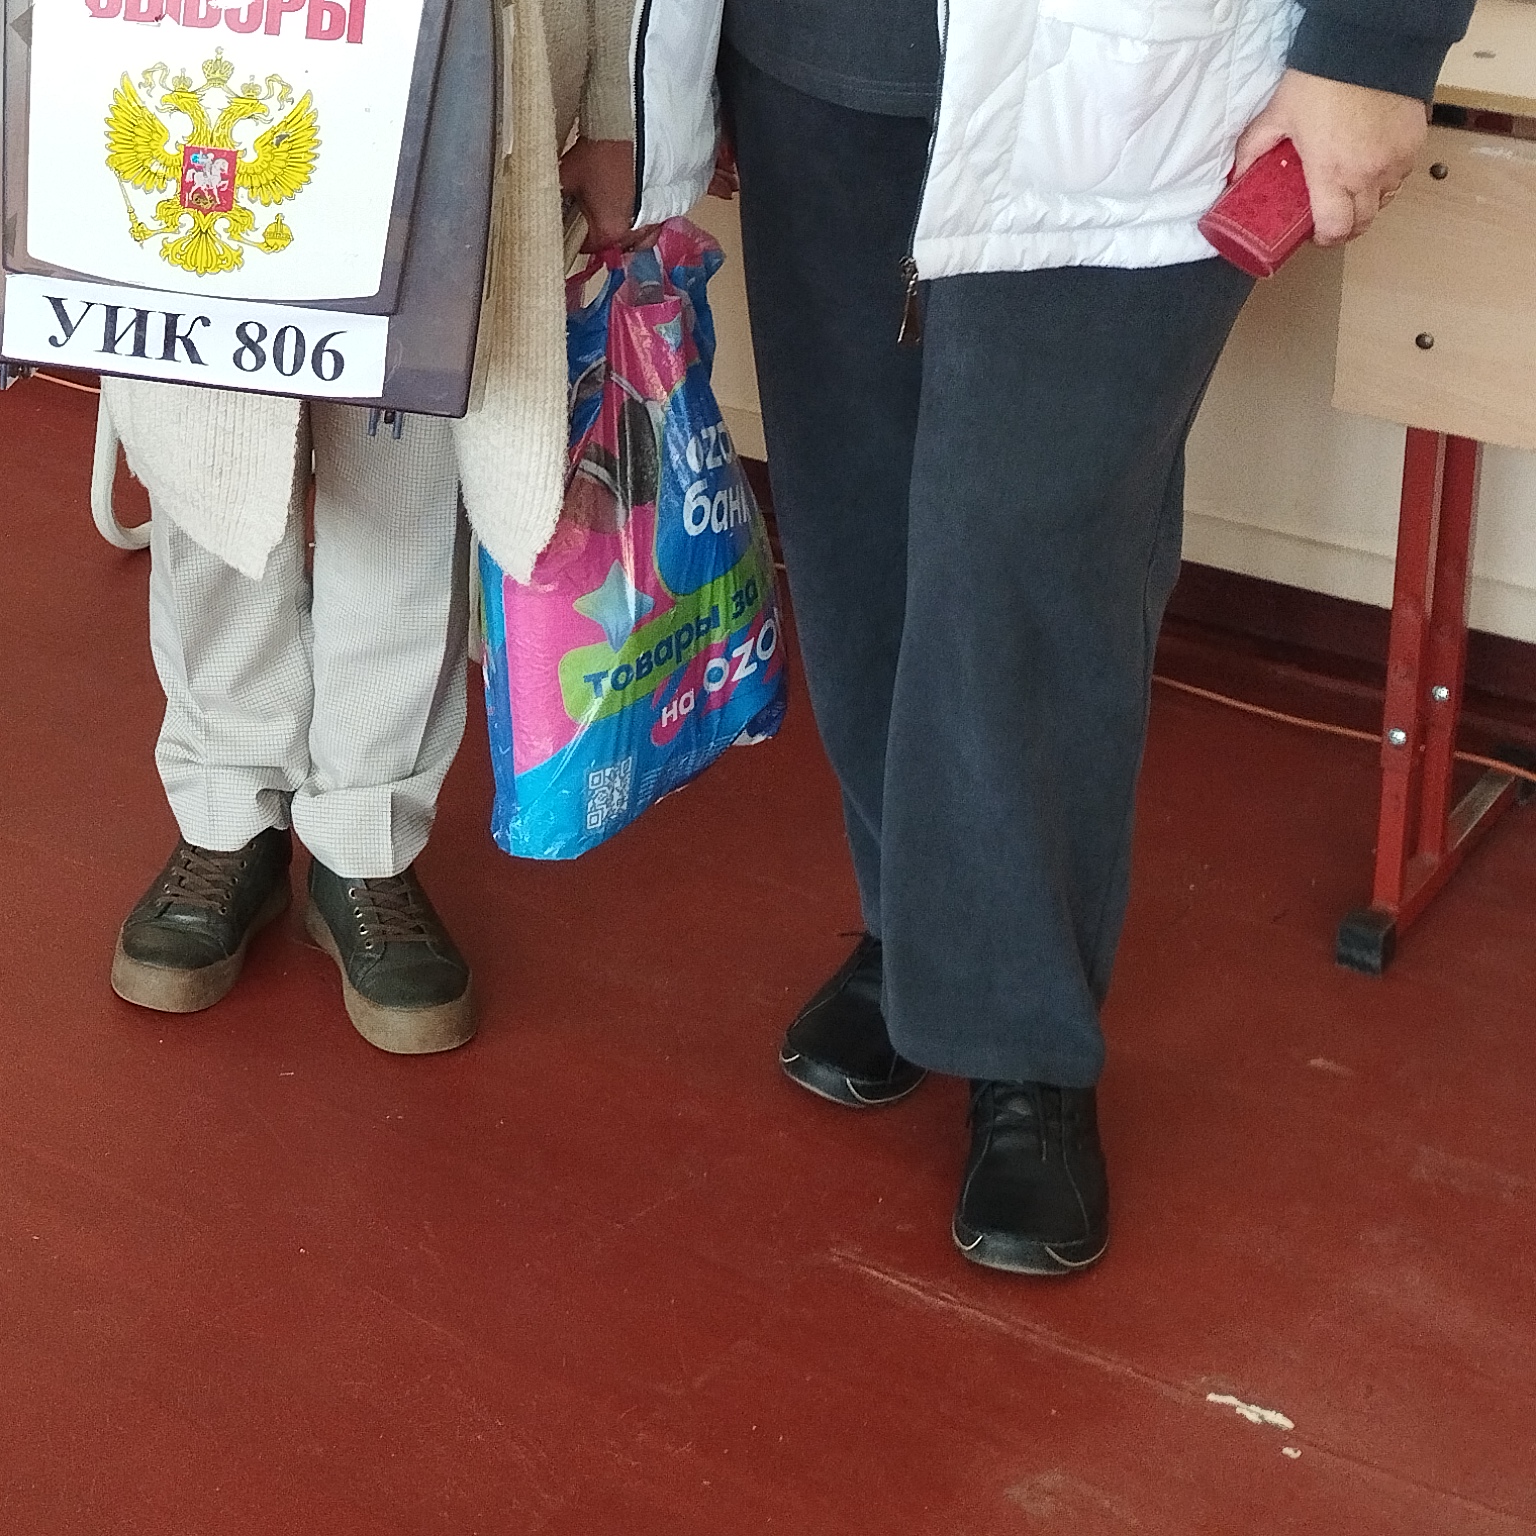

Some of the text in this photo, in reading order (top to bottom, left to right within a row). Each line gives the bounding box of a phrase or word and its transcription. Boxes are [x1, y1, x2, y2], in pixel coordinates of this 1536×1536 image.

[42, 295, 349, 382] УИК 806
[583, 578, 759, 698] товары за
[660, 688, 696, 728] на
